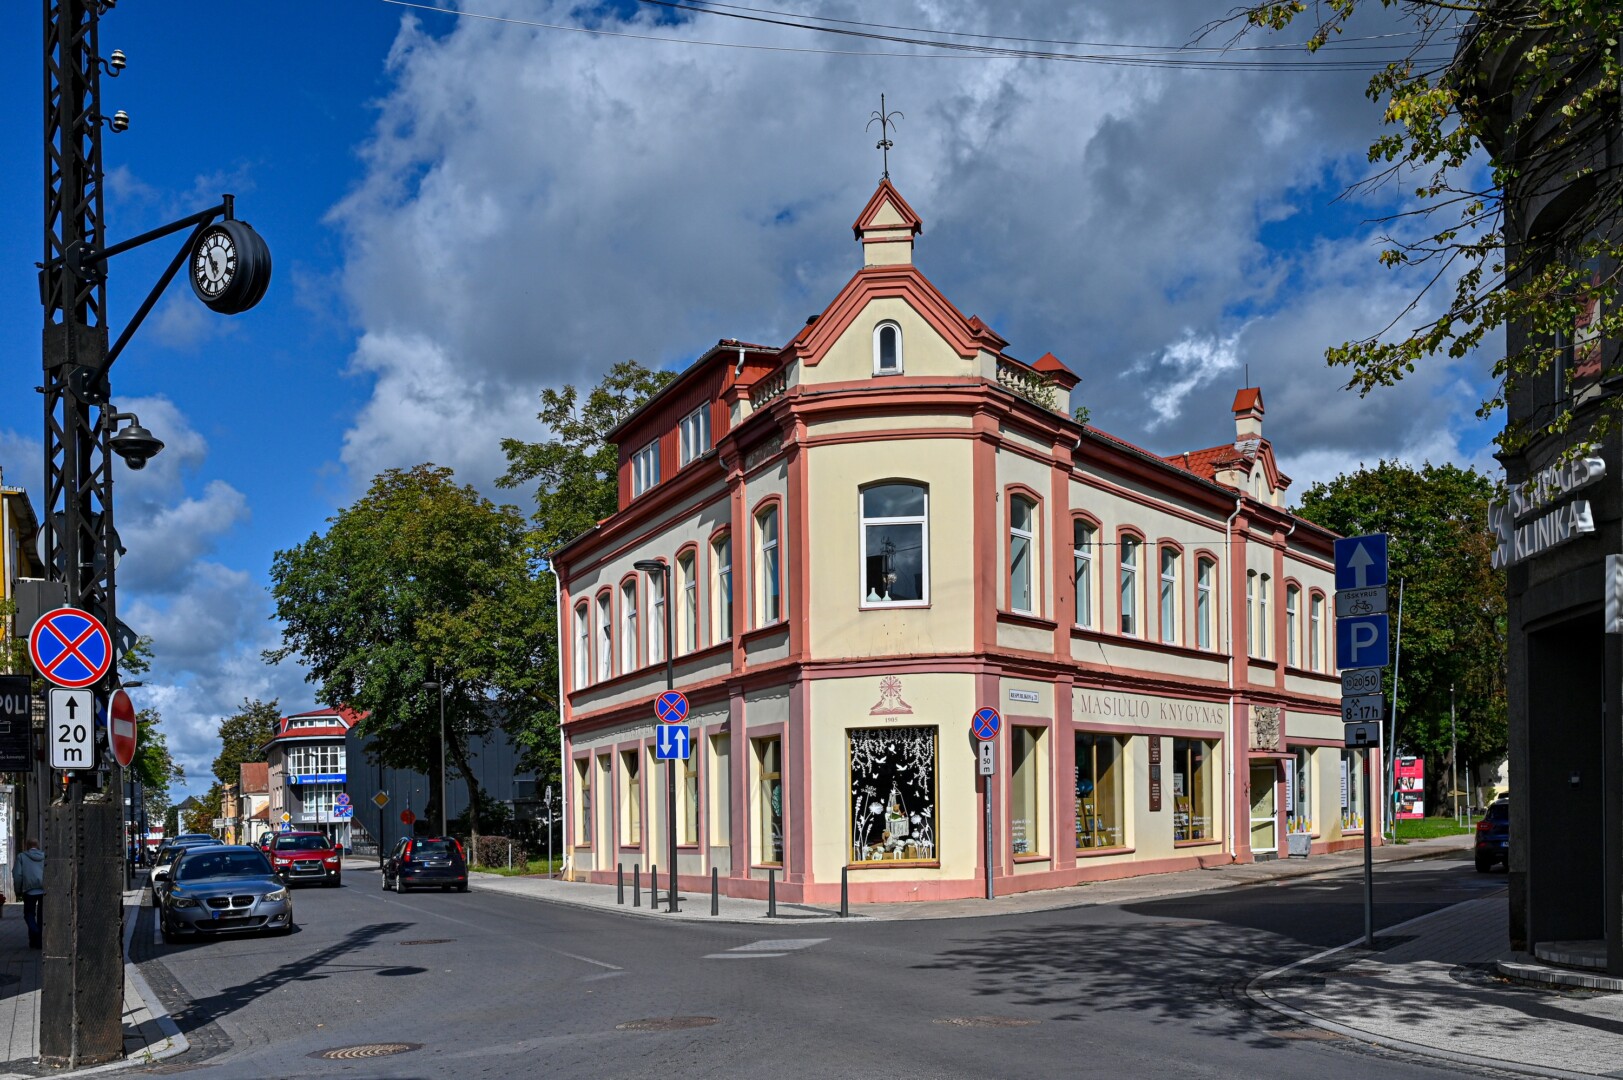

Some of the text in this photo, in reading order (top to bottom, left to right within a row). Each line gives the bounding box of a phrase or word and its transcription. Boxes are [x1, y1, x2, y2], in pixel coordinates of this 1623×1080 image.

[1514, 500, 1583, 562] KLINIKA
[1344, 590, 1378, 600] IŠSKYRUS
[1351, 622, 1379, 662] P
[1354, 677, 1363, 688] 20
[1364, 674, 1376, 687] 50
[1081, 694, 1150, 719] MASIULIO
[1160, 702, 1224, 725] KNYGYNAS
[58, 724, 87, 744] 20
[63, 748, 82, 762] m
